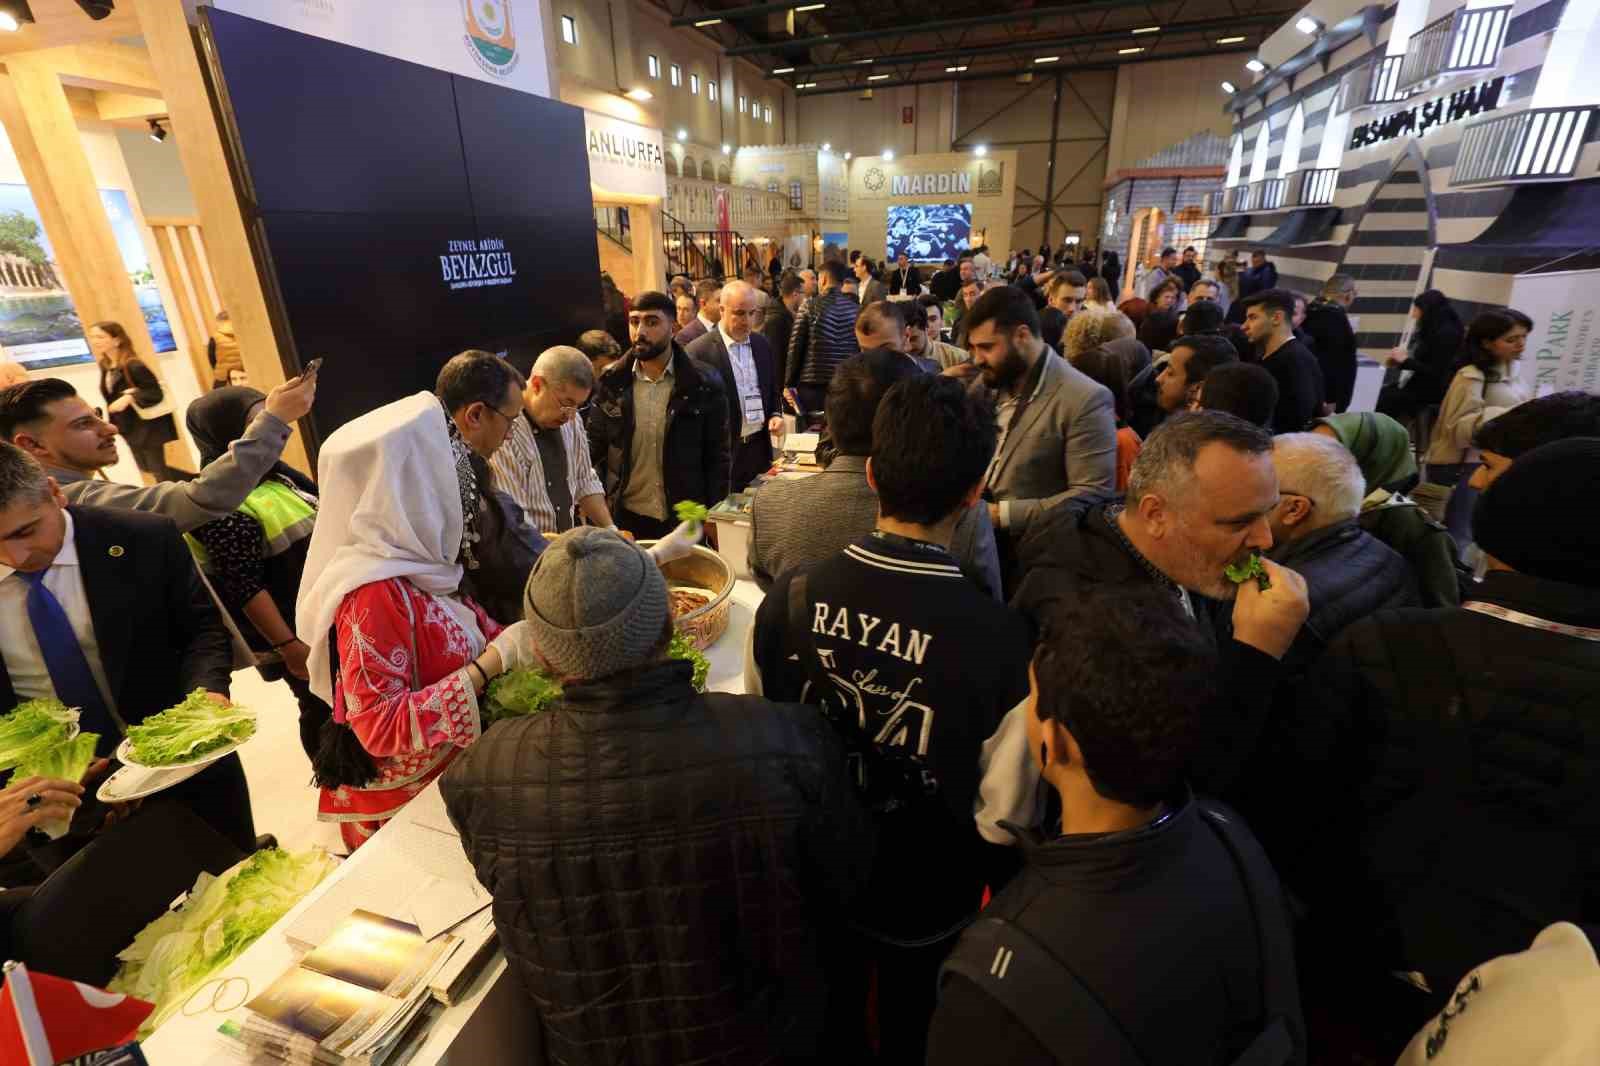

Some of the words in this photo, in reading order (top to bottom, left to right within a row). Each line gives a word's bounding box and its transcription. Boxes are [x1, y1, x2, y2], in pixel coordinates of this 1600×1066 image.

[589, 128, 663, 164] ANLIURFA
[891, 170, 971, 196] MARDİN
[439, 252, 516, 281] BEYAZGÜL
[1535, 309, 1575, 361] PARK
[812, 602, 933, 665] RAYAN
